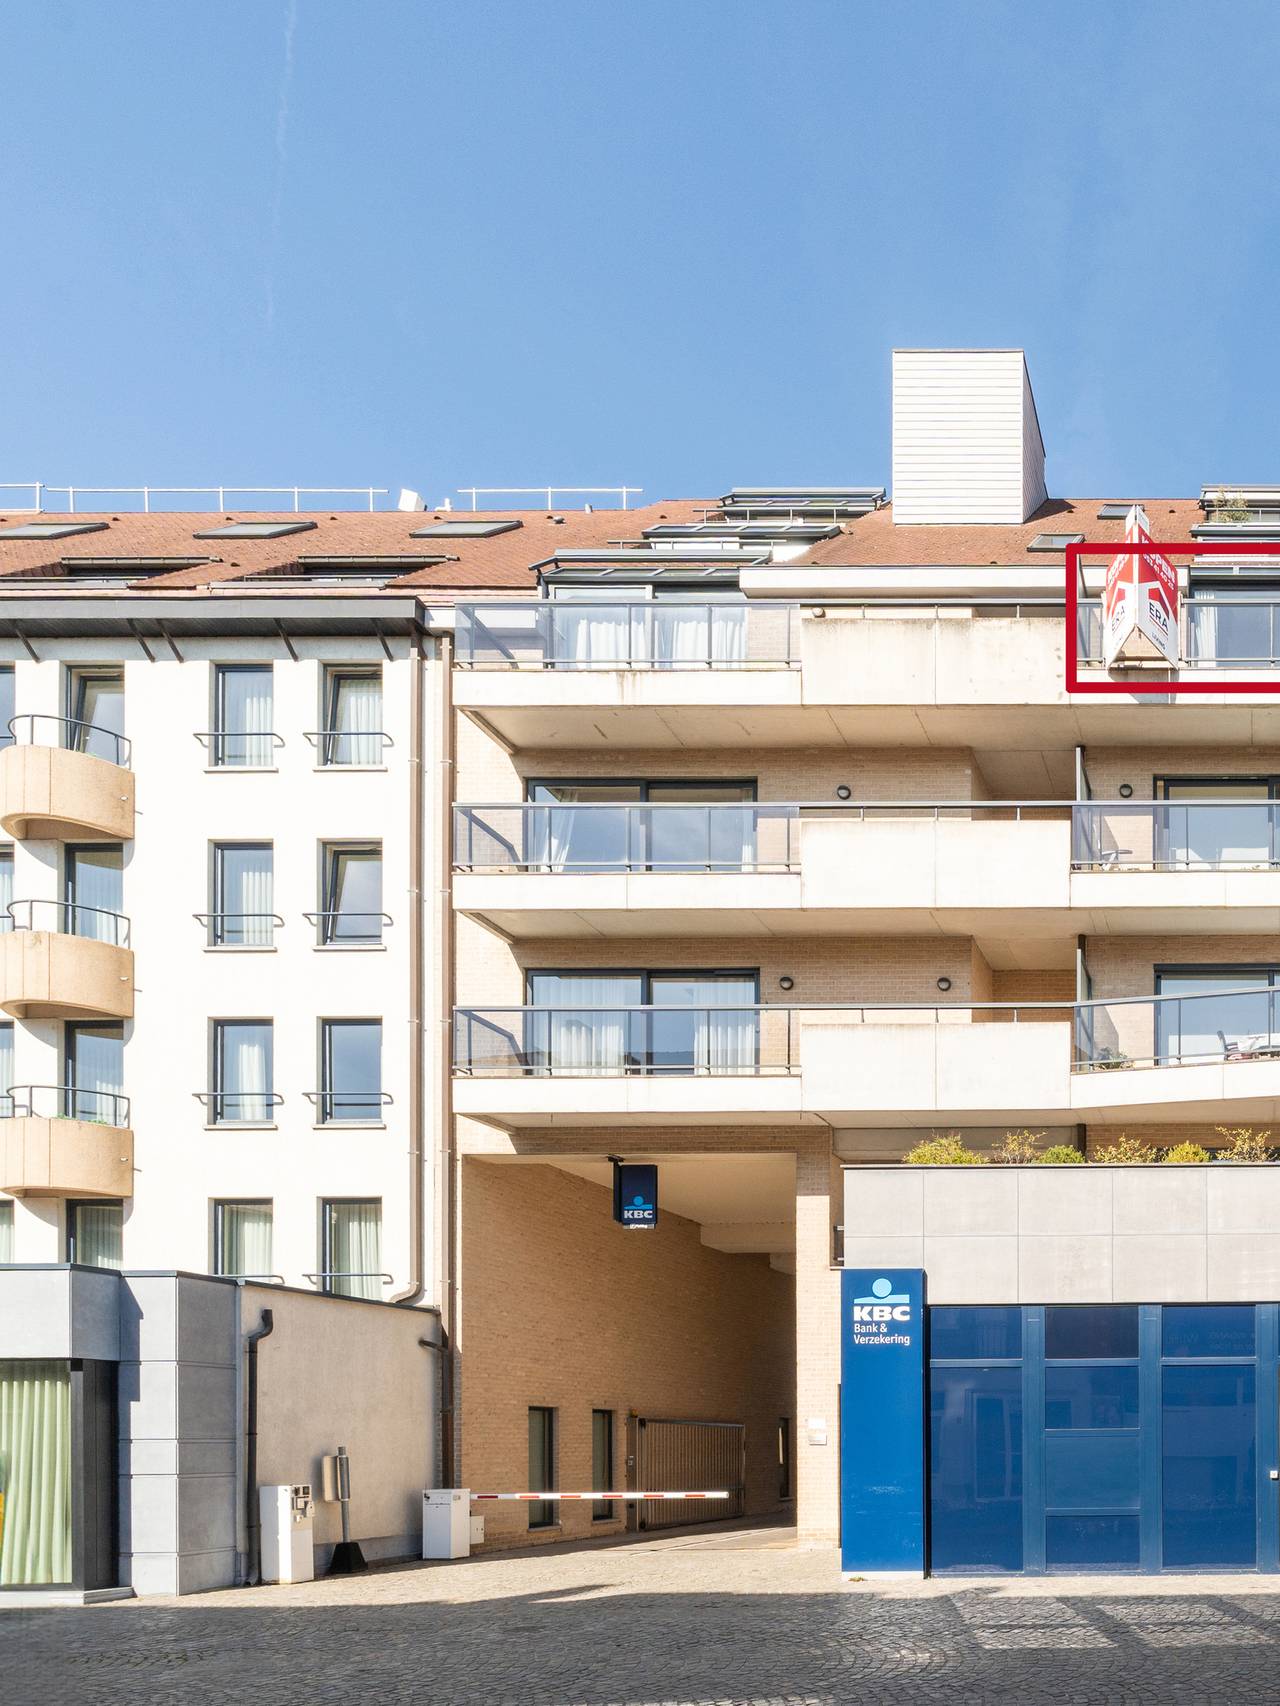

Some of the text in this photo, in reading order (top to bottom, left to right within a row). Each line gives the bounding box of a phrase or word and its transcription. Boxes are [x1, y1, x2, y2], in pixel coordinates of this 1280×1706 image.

[1149, 602, 1168, 632] ERA
[624, 1210, 653, 1219] KBC
[853, 1306, 910, 1321] KBC
[854, 1323, 888, 1333] Bank &
[853, 1333, 910, 1346] Verzekering
